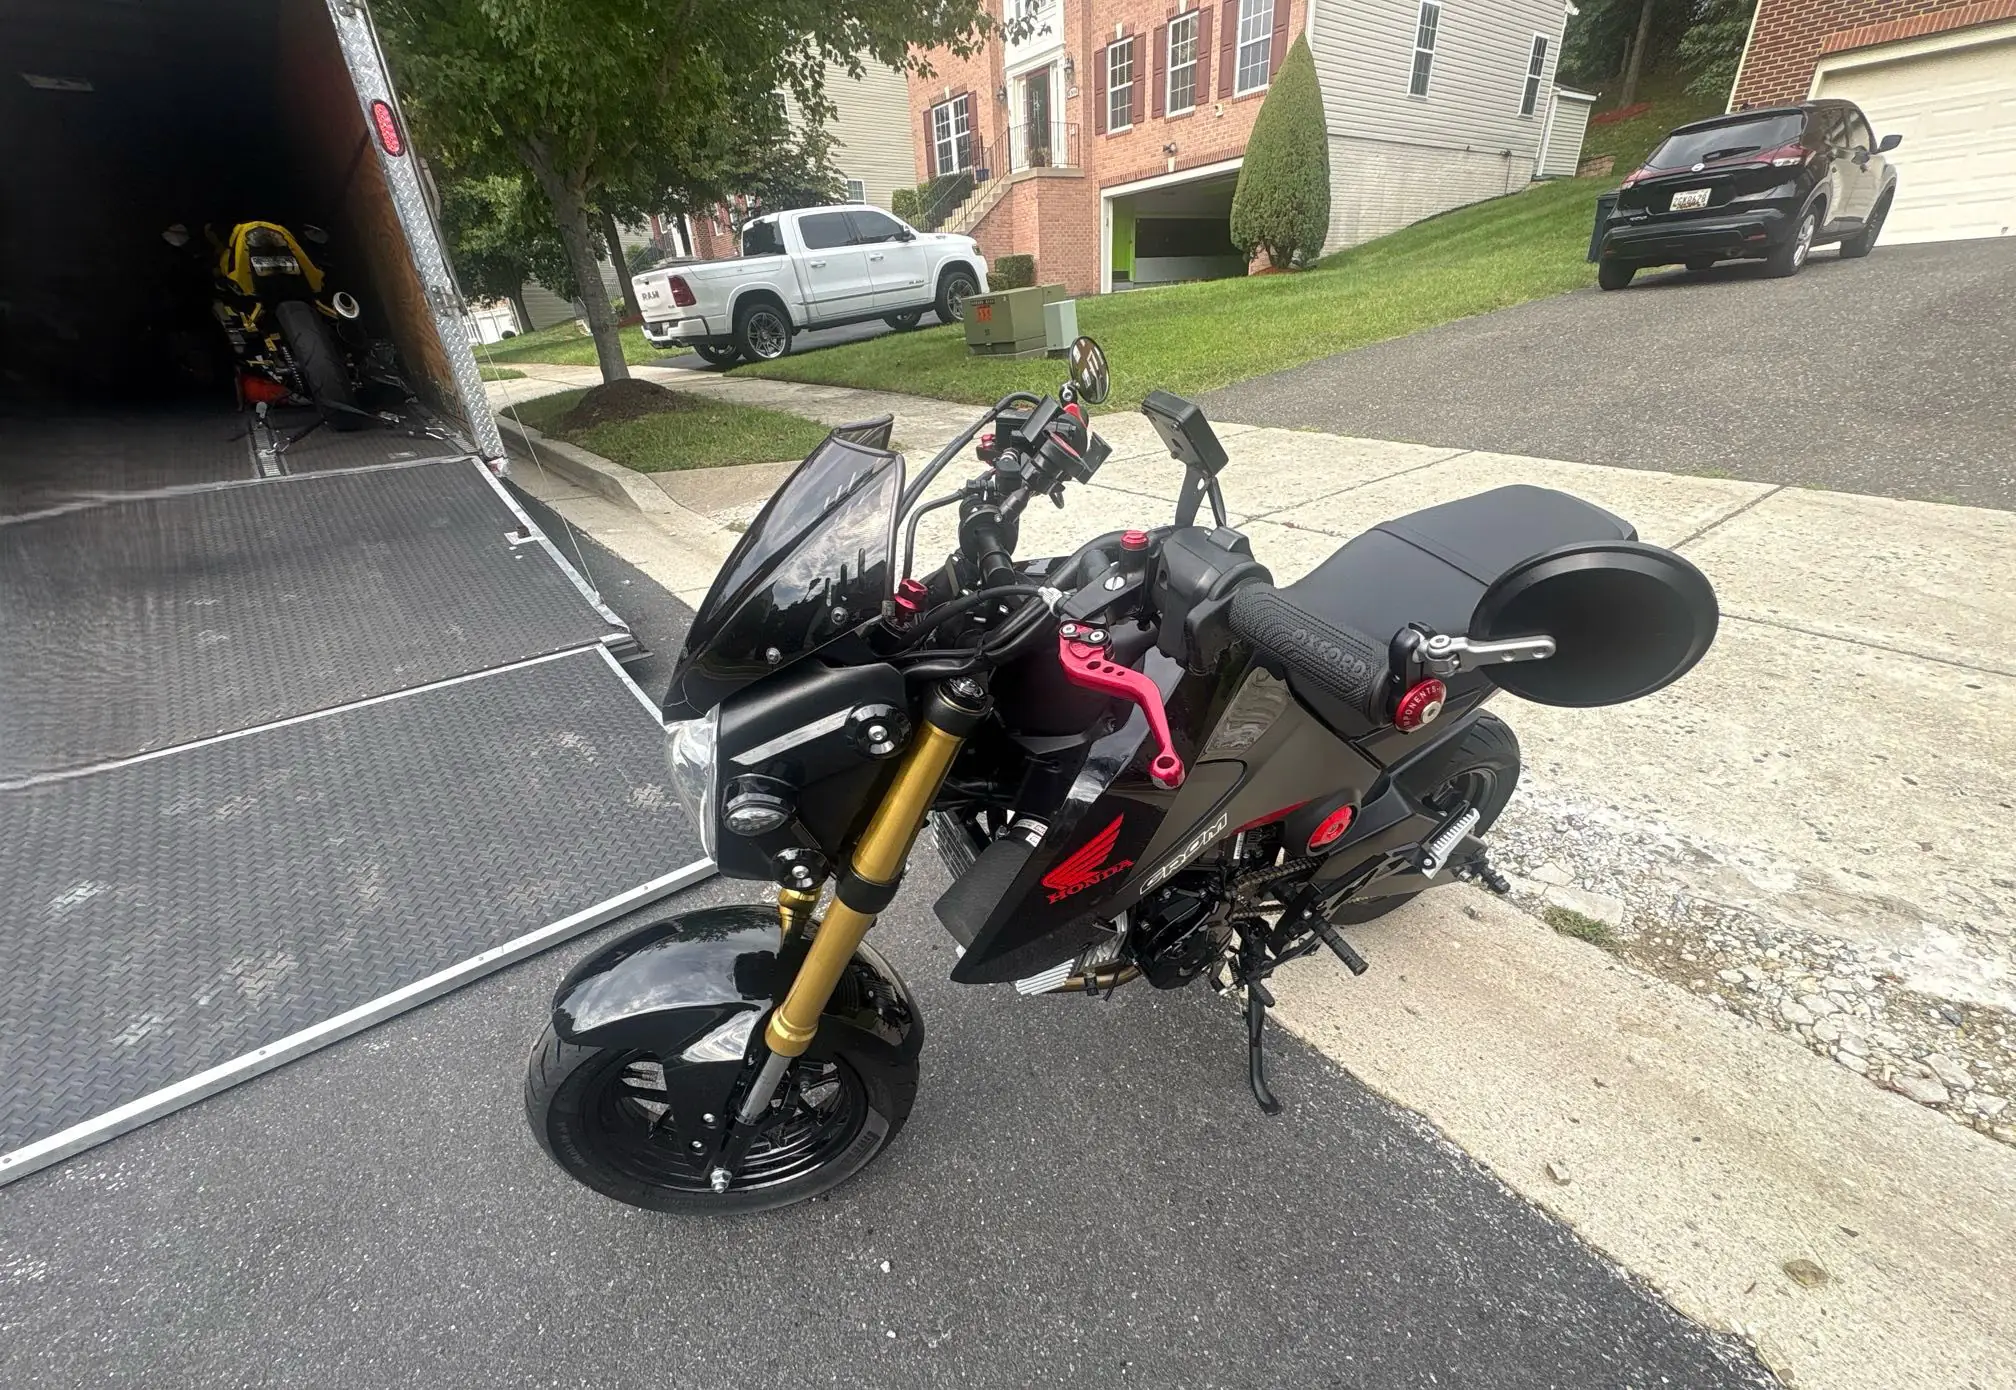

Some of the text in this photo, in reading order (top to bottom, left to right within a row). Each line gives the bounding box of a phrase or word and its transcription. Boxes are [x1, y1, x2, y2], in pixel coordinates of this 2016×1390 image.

[641, 290, 660, 301] RAM
[1292, 628, 1367, 676] OXFORD
[1139, 812, 1228, 895] GROM
[1046, 859, 1135, 904] HONDA
